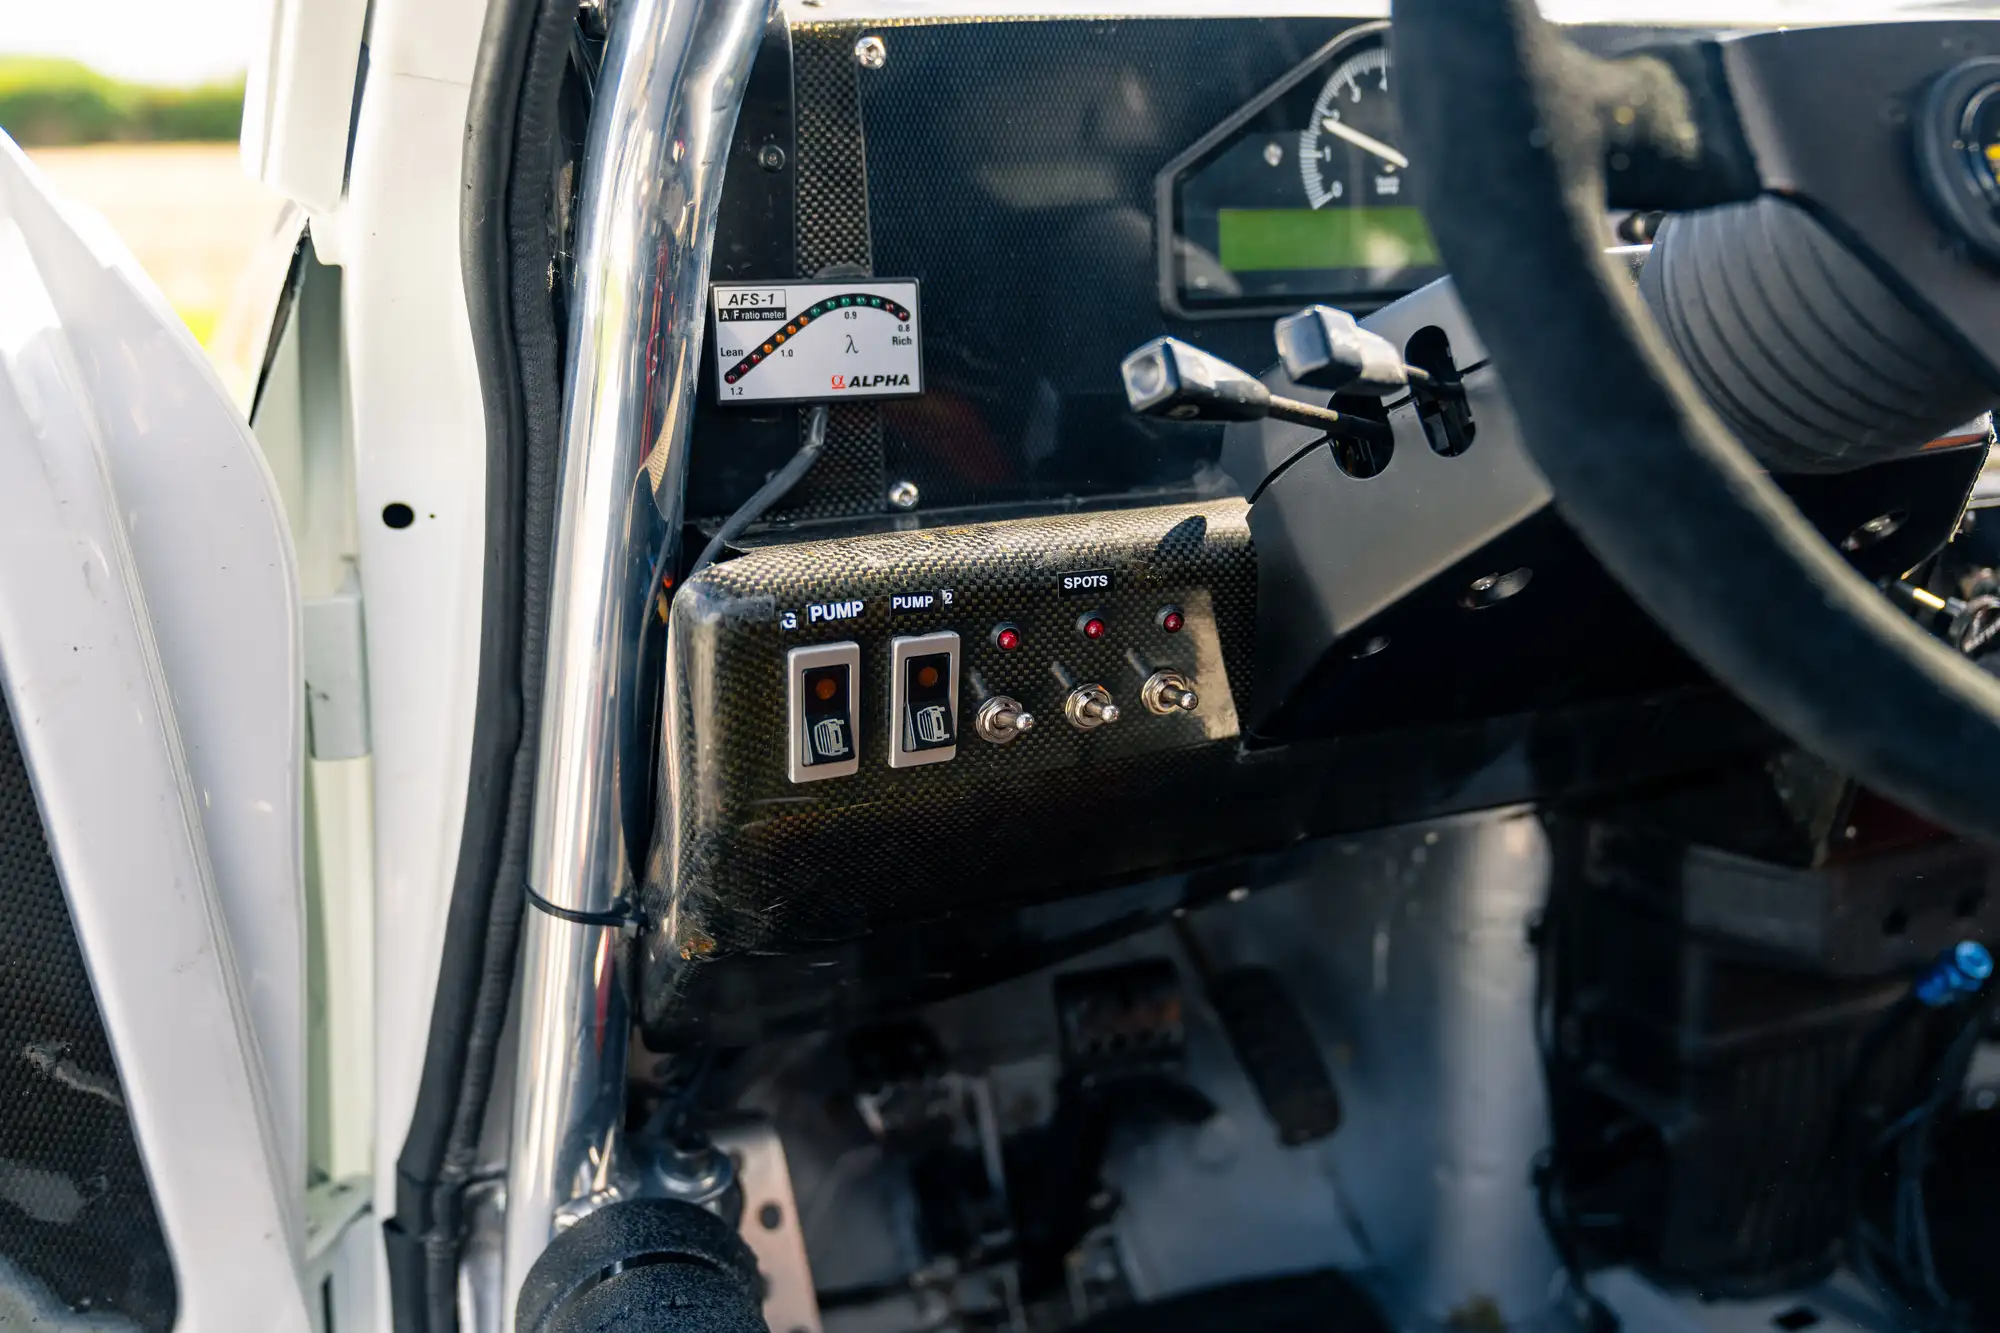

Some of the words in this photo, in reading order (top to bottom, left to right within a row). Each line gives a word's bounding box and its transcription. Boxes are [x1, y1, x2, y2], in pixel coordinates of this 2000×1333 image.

[728, 292, 775, 306] AFS-1
[741, 311, 761, 320] ratio
[761, 309, 786, 320] meter
[844, 310, 858, 320] 0.9
[897, 323, 911, 333] 0.8
[892, 336, 913, 346] Rich
[720, 346, 744, 357] Lean
[780, 348, 794, 358] 1.0
[848, 373, 911, 389] ALPHA
[730, 386, 744, 396] 1.2
[1063, 574, 1109, 590] SPOTS
[892, 595, 934, 610] PUMP
[809, 600, 865, 623] PUMP
